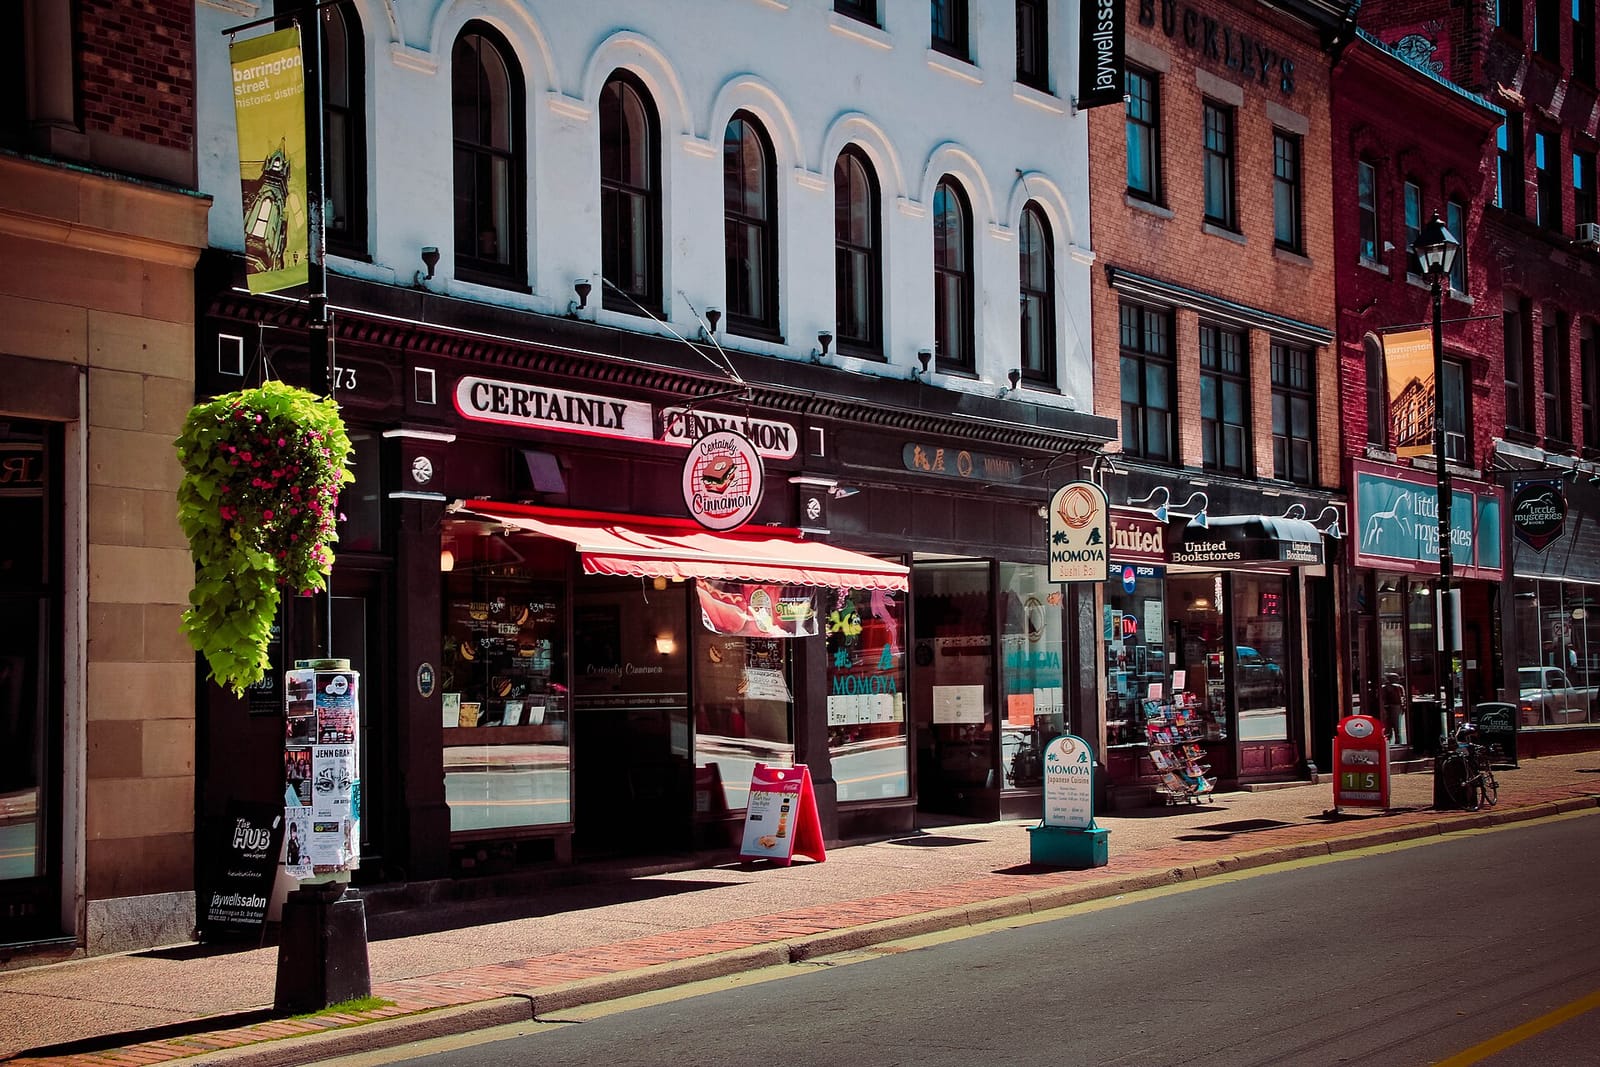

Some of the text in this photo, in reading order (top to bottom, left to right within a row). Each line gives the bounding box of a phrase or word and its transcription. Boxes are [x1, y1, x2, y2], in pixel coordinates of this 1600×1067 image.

[233, 55, 300, 82] barrington
[234, 77, 270, 95] street
[235, 94, 272, 108] historic
[470, 381, 628, 431] CERTAINLY
[700, 439, 737, 456] Certainly
[693, 493, 752, 514] Cinnamon
[1185, 541, 1226, 552] United
[1292, 542, 1311, 552] United
[1052, 549, 1104, 562] MOMOYA
[1172, 551, 1241, 562] Bookstores
[1286, 550, 1318, 562] Bookstores
[1109, 564, 1122, 573] EPSI
[1136, 567, 1154, 576] PEPSI
[1122, 619, 1138, 634] TM
[833, 674, 897, 695] MOMOYA
[316, 749, 334, 758] JENN
[1047, 765, 1090, 775] MOMOYA
[1047, 776, 1089, 785] Japanese Cuisine
[232, 827, 271, 850] HUB
[211, 891, 267, 908] jaywellssalon
